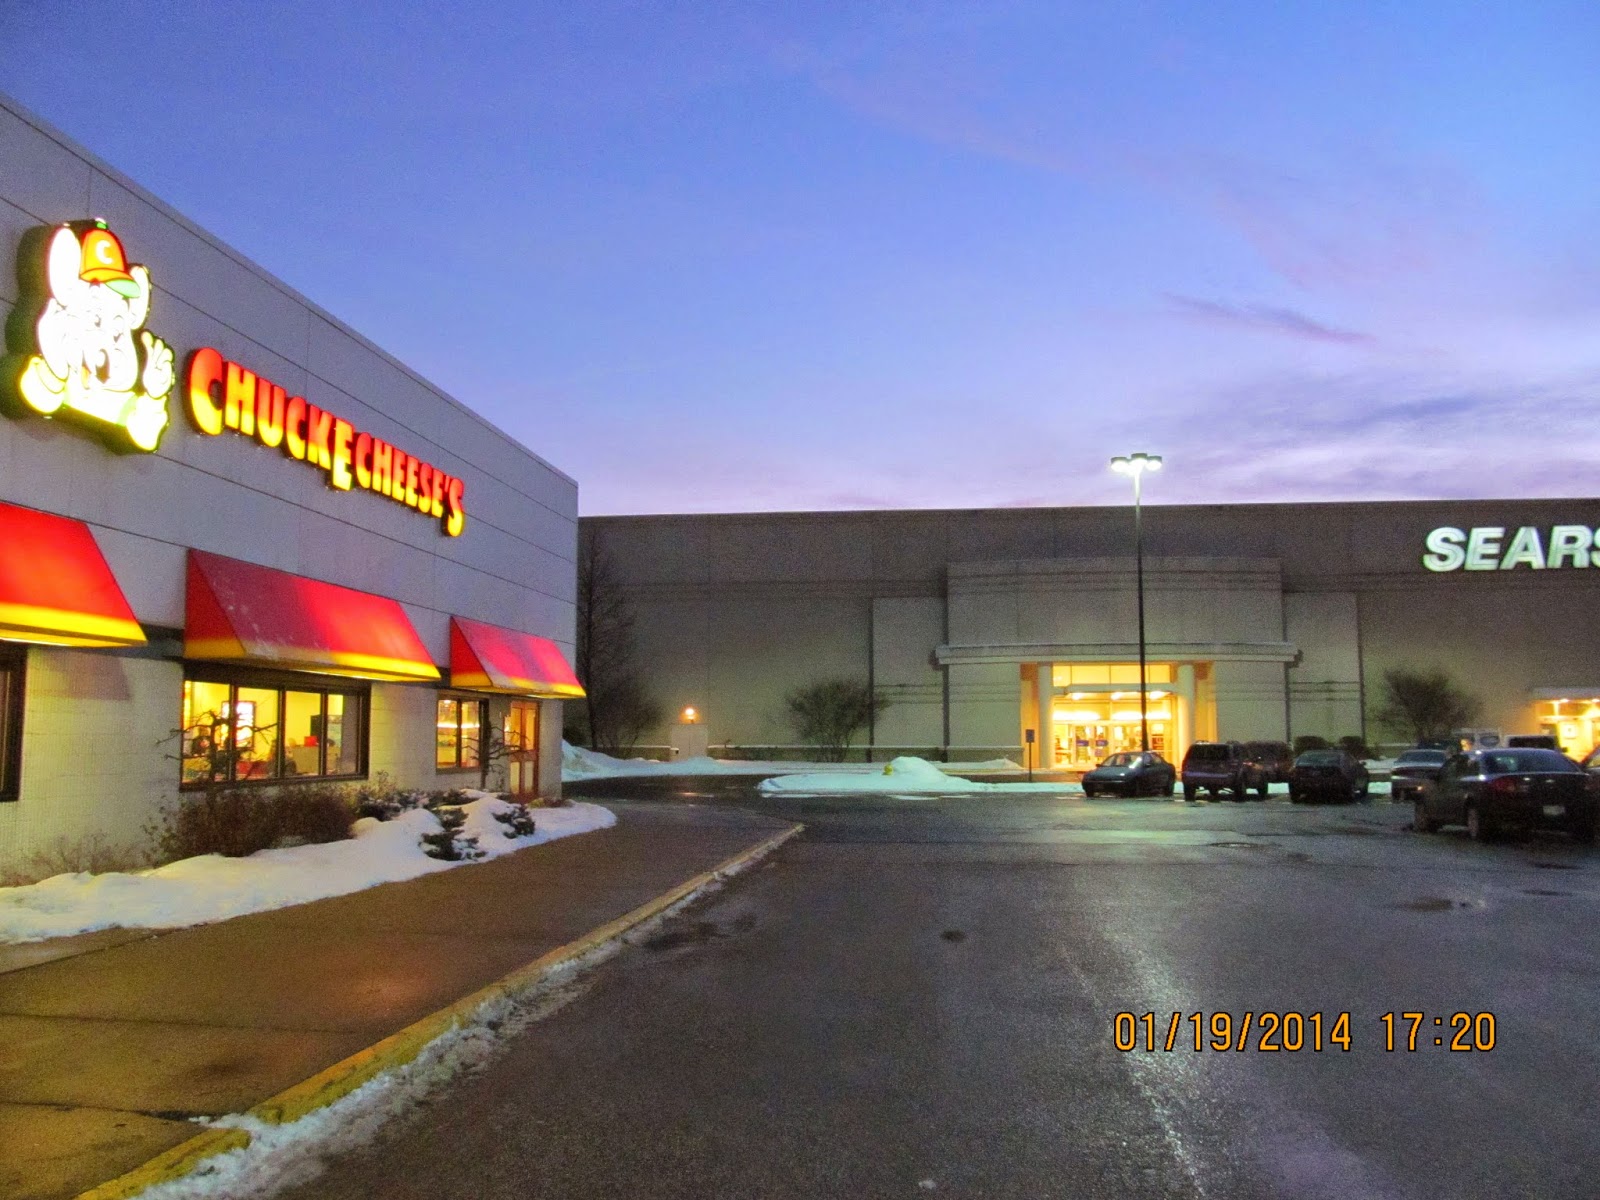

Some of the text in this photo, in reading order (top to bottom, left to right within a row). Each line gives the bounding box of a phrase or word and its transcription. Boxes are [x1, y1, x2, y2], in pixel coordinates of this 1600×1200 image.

[95, 239, 114, 265] C
[189, 346, 465, 537] CHUCK E CHEESE'S
[1423, 525, 1600, 572] SEAR
